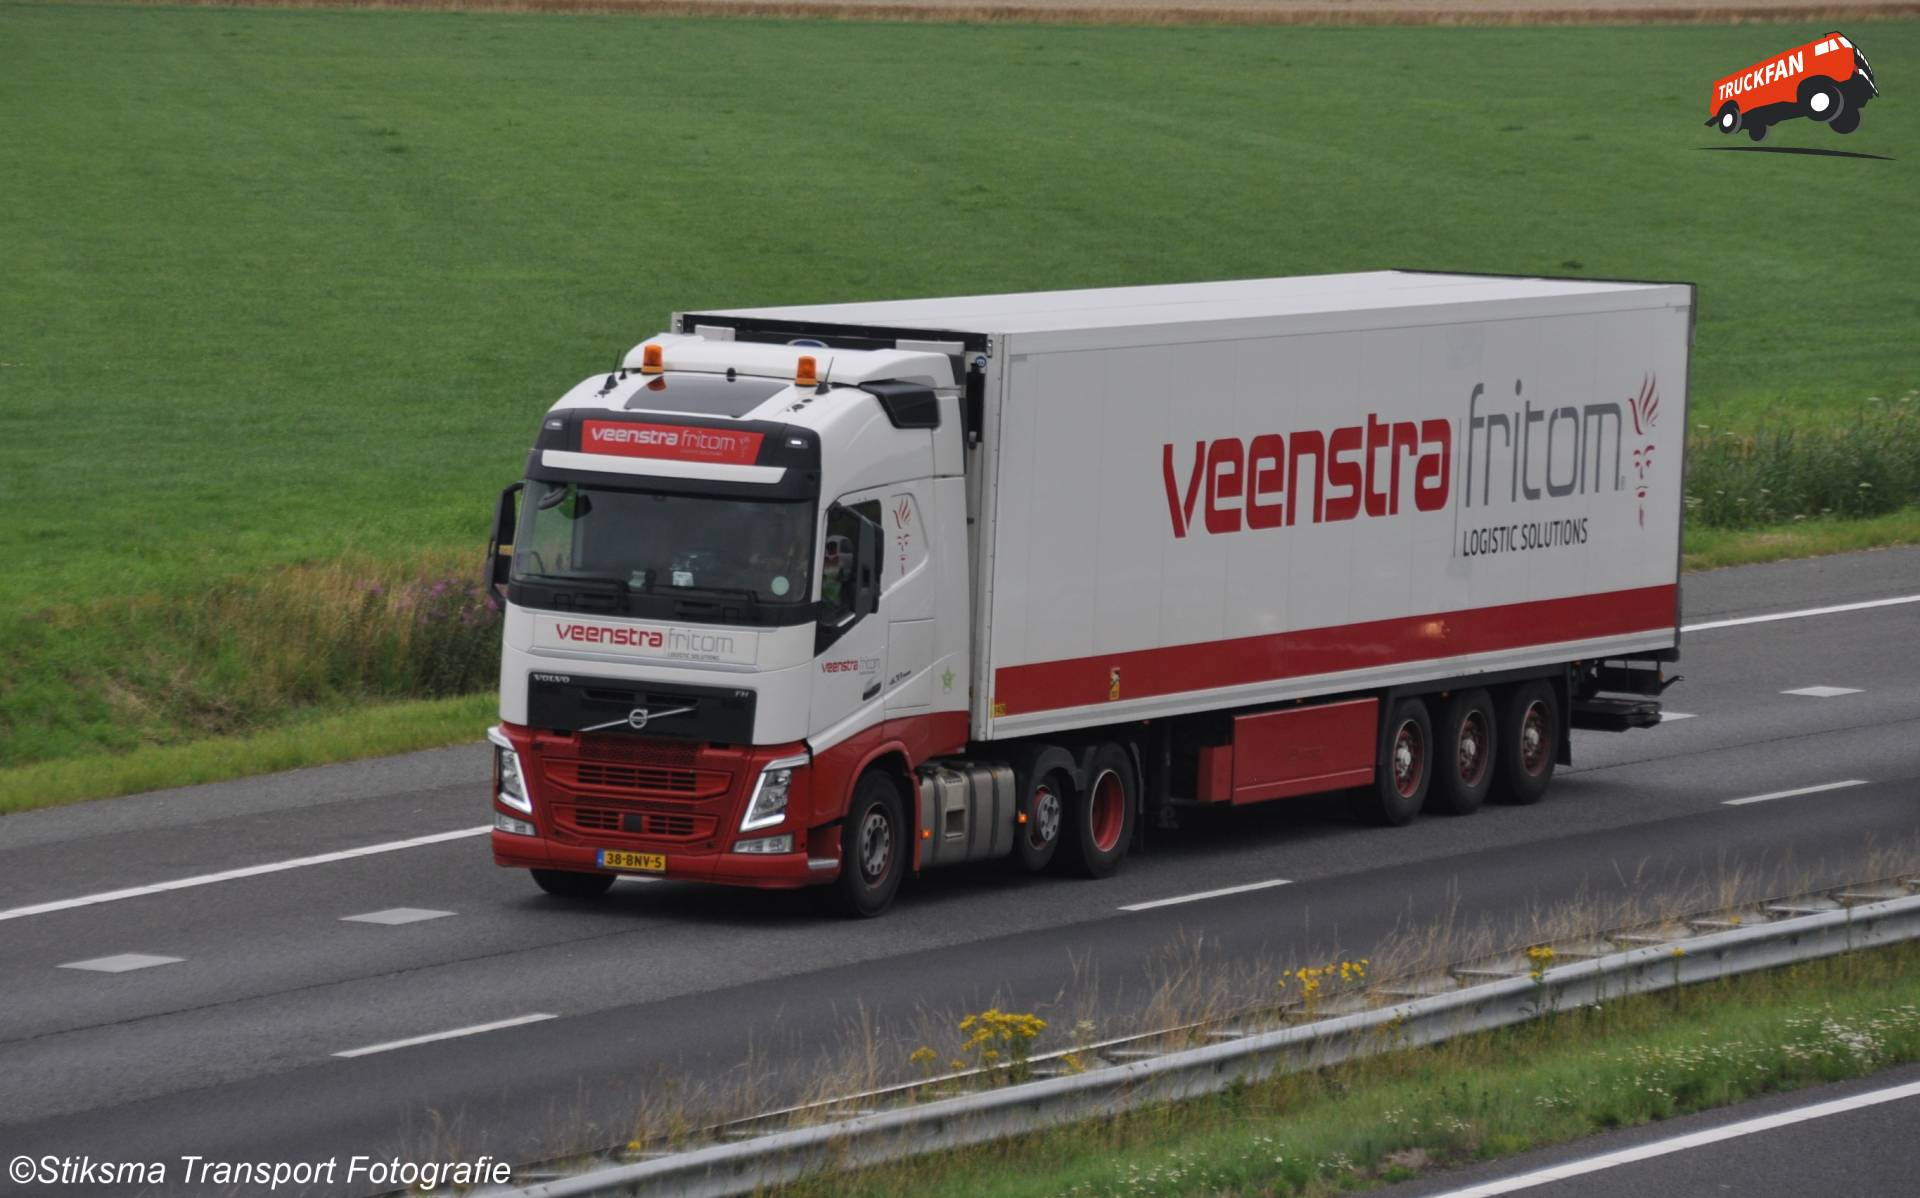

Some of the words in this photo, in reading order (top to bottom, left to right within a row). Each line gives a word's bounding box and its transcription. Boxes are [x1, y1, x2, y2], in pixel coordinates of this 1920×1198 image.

[592, 427, 678, 446] veenstra
[681, 429, 735, 450] fritom
[1163, 413, 1451, 538] veenstra
[1466, 379, 1622, 508] fritom
[1463, 524, 1517, 557] LOGISTIC
[1520, 518, 1588, 551] SOLUTIONS
[556, 623, 663, 648] veenstra
[668, 628, 734, 653] fritom
[534, 674, 570, 683] VOLVO
[607, 853, 662, 868] 38-BNV-5
